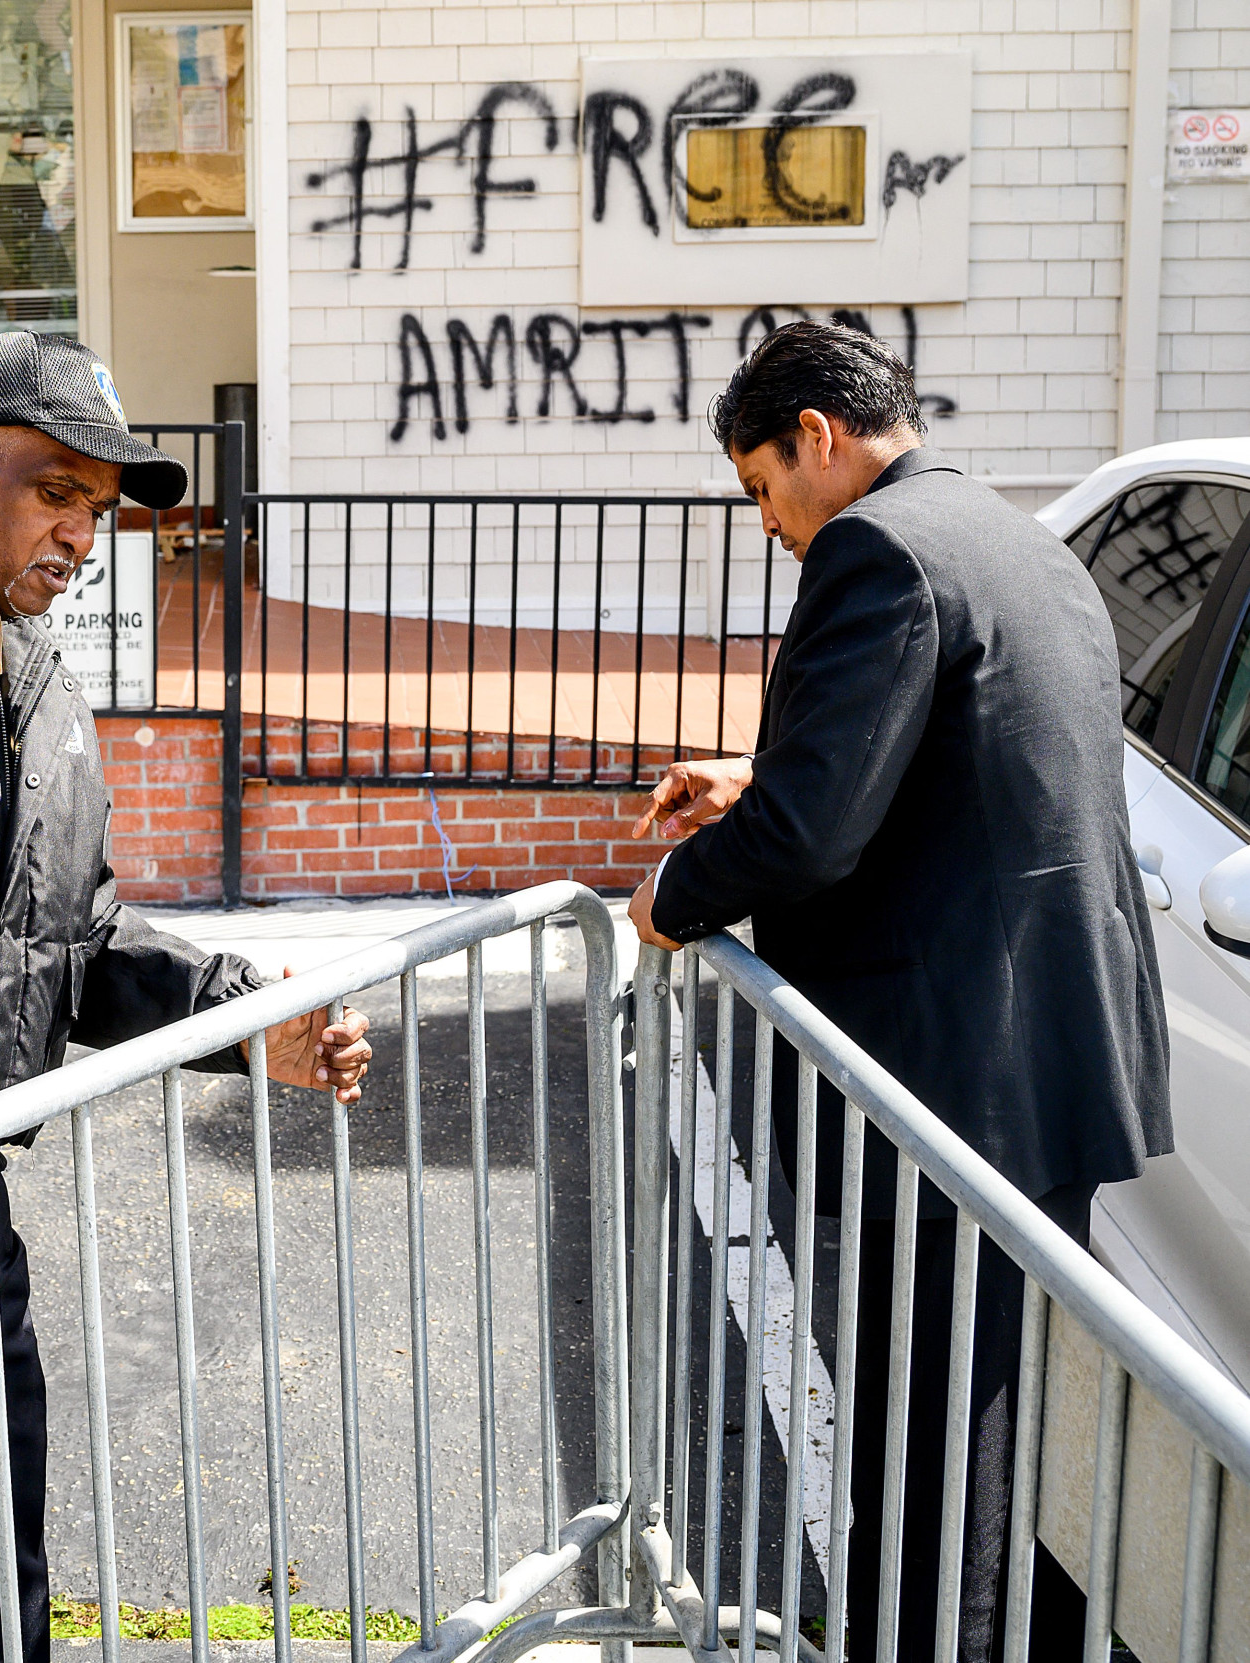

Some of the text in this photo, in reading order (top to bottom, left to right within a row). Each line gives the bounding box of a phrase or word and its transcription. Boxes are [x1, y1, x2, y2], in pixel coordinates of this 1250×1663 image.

[1174, 144, 1248, 156] NO SMOKING
[1178, 157, 1242, 168] NO VAPING
[65, 612, 143, 630] PARKNG
[89, 679, 145, 689] EXPNSE
